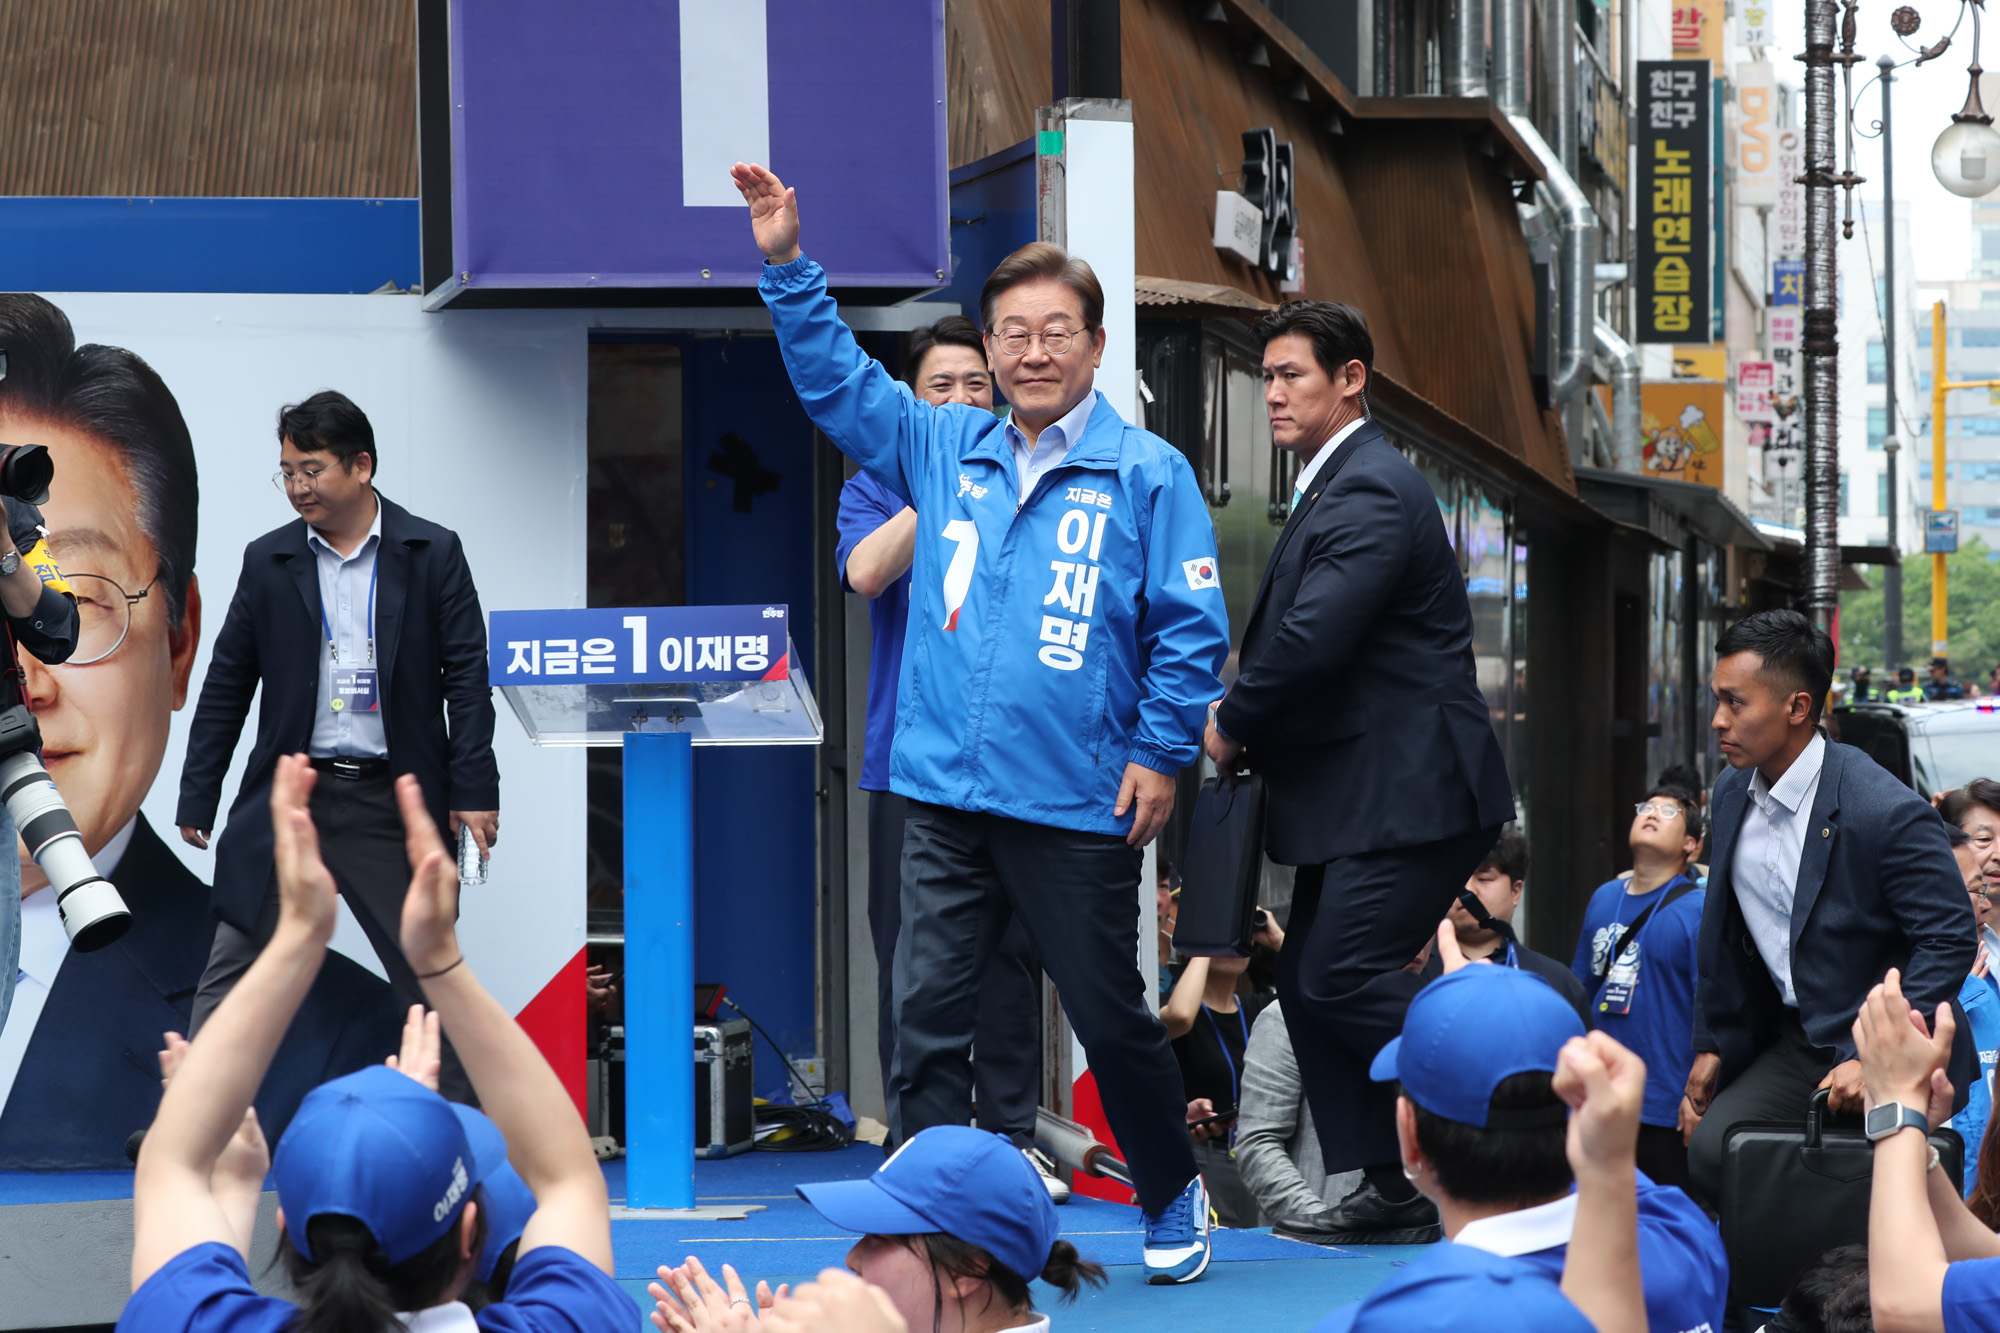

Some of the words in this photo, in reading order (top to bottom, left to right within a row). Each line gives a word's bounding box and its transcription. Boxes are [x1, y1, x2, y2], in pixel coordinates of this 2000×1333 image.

[1650, 71, 1697, 97] 친구
[1650, 101, 1697, 128] 친구
[1741, 86, 1769, 172] DVD
[1652, 139, 1693, 331] 노래연습장
[1064, 486, 1112, 510] 지금은
[941, 519, 980, 632] 1
[1038, 509, 1107, 671] 이재명
[506, 638, 616, 676] 지금은
[623, 616, 648, 674] 1
[659, 635, 769, 673] 이재명
